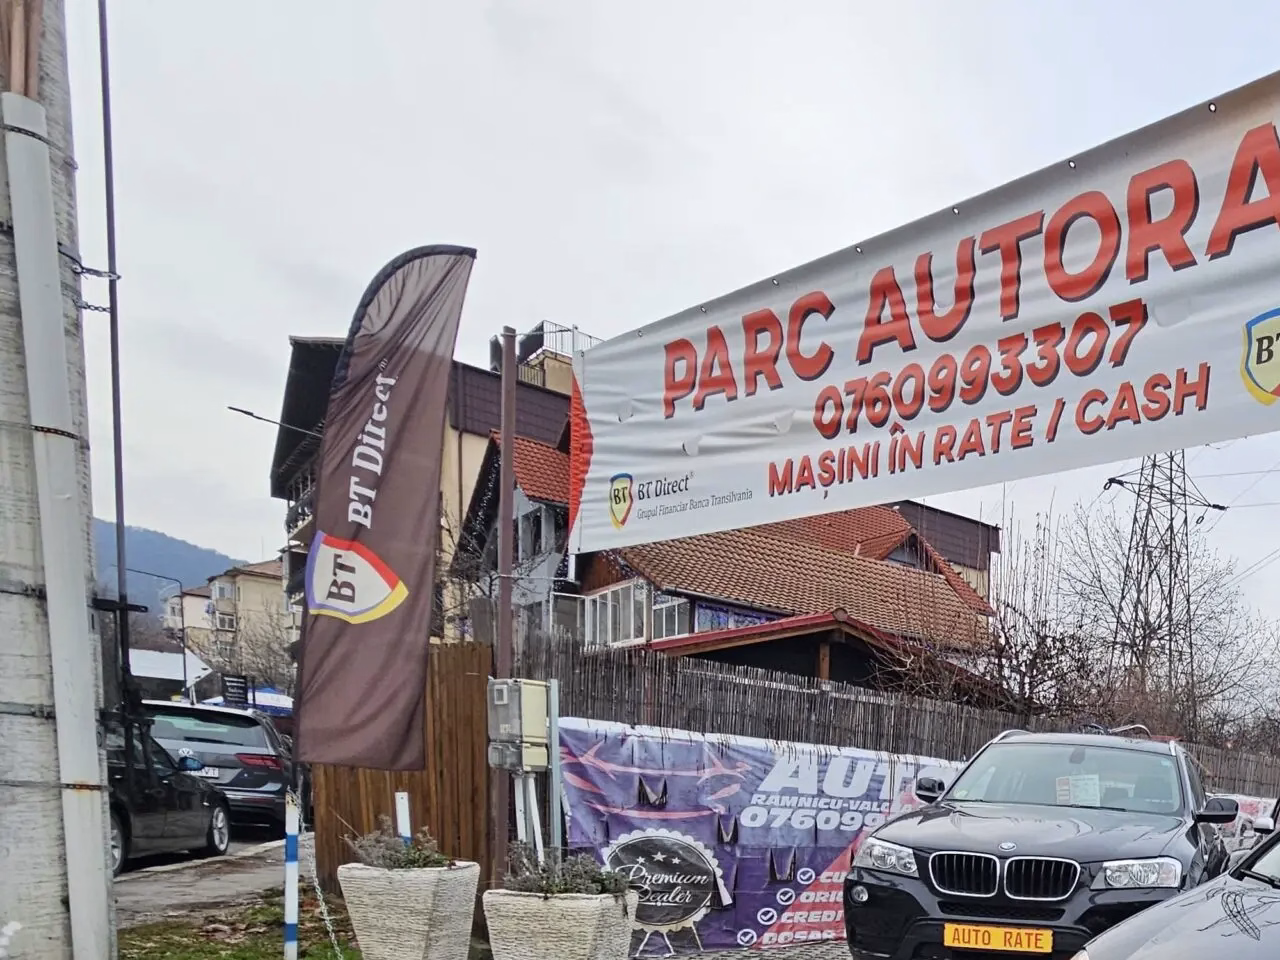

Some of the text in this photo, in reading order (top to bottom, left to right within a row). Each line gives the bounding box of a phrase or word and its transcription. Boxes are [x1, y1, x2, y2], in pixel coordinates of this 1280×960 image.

[663, 290, 835, 420] PARC
[812, 298, 1147, 438] 0760993307
[769, 362, 1210, 499] MAȘINI ÎN RATE / CASH
[348, 476, 377, 529] BT
[613, 486, 628, 505] BT
[637, 481, 652, 500] BT
[637, 488, 753, 520] Grupul Financiar Banca Transilvania
[326, 554, 357, 604] BT
[615, 864, 709, 885] Premium
[951, 926, 1044, 949] AUTO RATE
